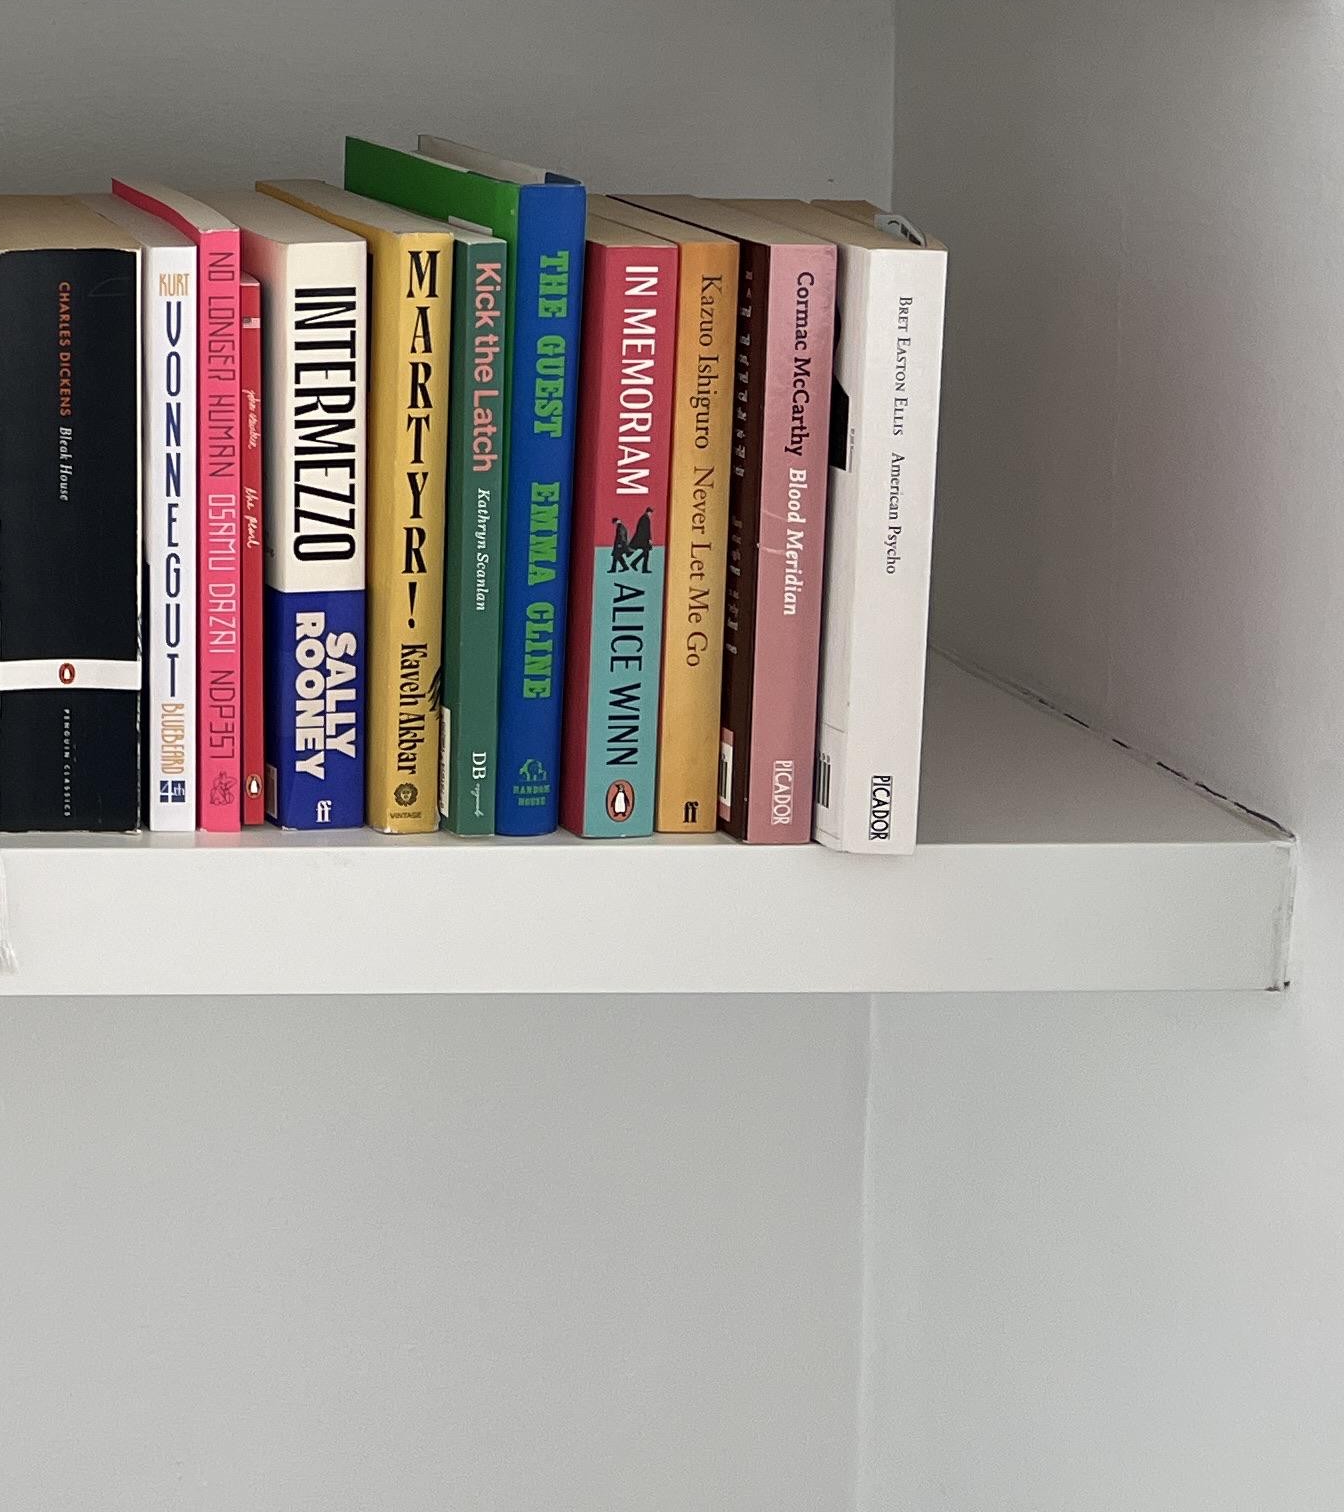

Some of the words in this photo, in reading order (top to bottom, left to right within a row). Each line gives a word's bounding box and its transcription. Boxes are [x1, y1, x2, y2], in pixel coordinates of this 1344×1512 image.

[474, 262, 502, 327] Kick
[624, 264, 658, 296] IN
[794, 271, 814, 352] Cormac
[474, 333, 498, 383] the
[294, 286, 357, 563] INTERMEZZO
[473, 390, 500, 473] Latch
[616, 307, 656, 496] MEMORIAM
[784, 357, 812, 458] McCarthy
[60, 427, 73, 463] Bleak
[61, 465, 73, 501] House
[165, 301, 183, 698] VONNEGUT
[693, 466, 716, 534] Never
[690, 542, 712, 580] Let
[608, 583, 644, 674] ALICE
[689, 589, 711, 624] Me
[686, 631, 709, 669] Go
[295, 613, 326, 780] ROONEY
[325, 631, 357, 758] SALLY
[606, 684, 641, 766] WINN
[870, 776, 890, 842] PICADOR
